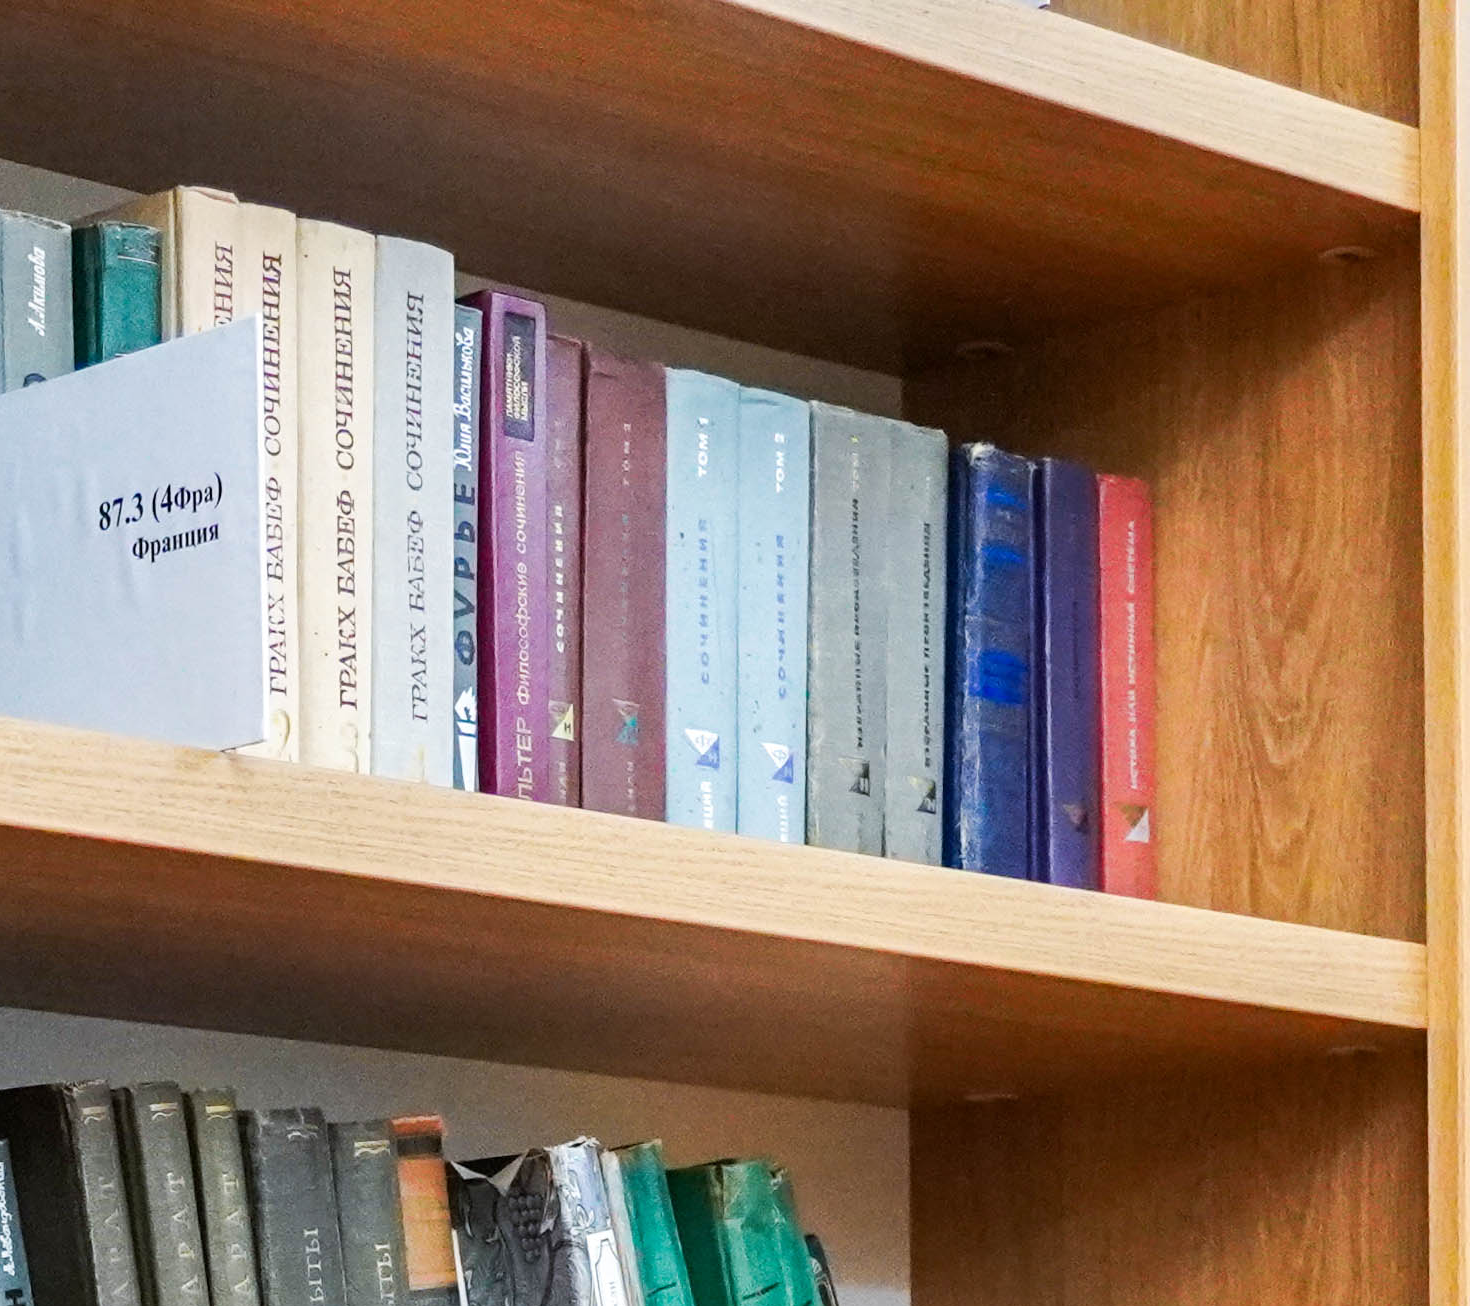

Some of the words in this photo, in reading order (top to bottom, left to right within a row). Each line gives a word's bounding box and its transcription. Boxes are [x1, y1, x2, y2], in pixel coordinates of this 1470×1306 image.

[263, 252, 282, 457] СОЧИНЕНИЯ
[333, 265, 355, 472] СОЧИНЕНИЯ
[405, 291, 426, 493] СОЧИНЕНИЯ
[98, 496, 145, 533] 87.3
[151, 473, 223, 525] (4Фра)
[132, 523, 220, 563] Франция
[267, 477, 286, 598] БАБЕФ
[336, 489, 356, 597] БАБЕФ
[512, 450, 530, 552] сочинения
[407, 509, 427, 615] БАБЕФ
[453, 482, 477, 666] ФУРЬЕ
[269, 608, 288, 696] ГРАКХ
[337, 606, 358, 711] ГРАКХ
[412, 624, 429, 723] ГРАКХ
[514, 560, 532, 706] Философские
